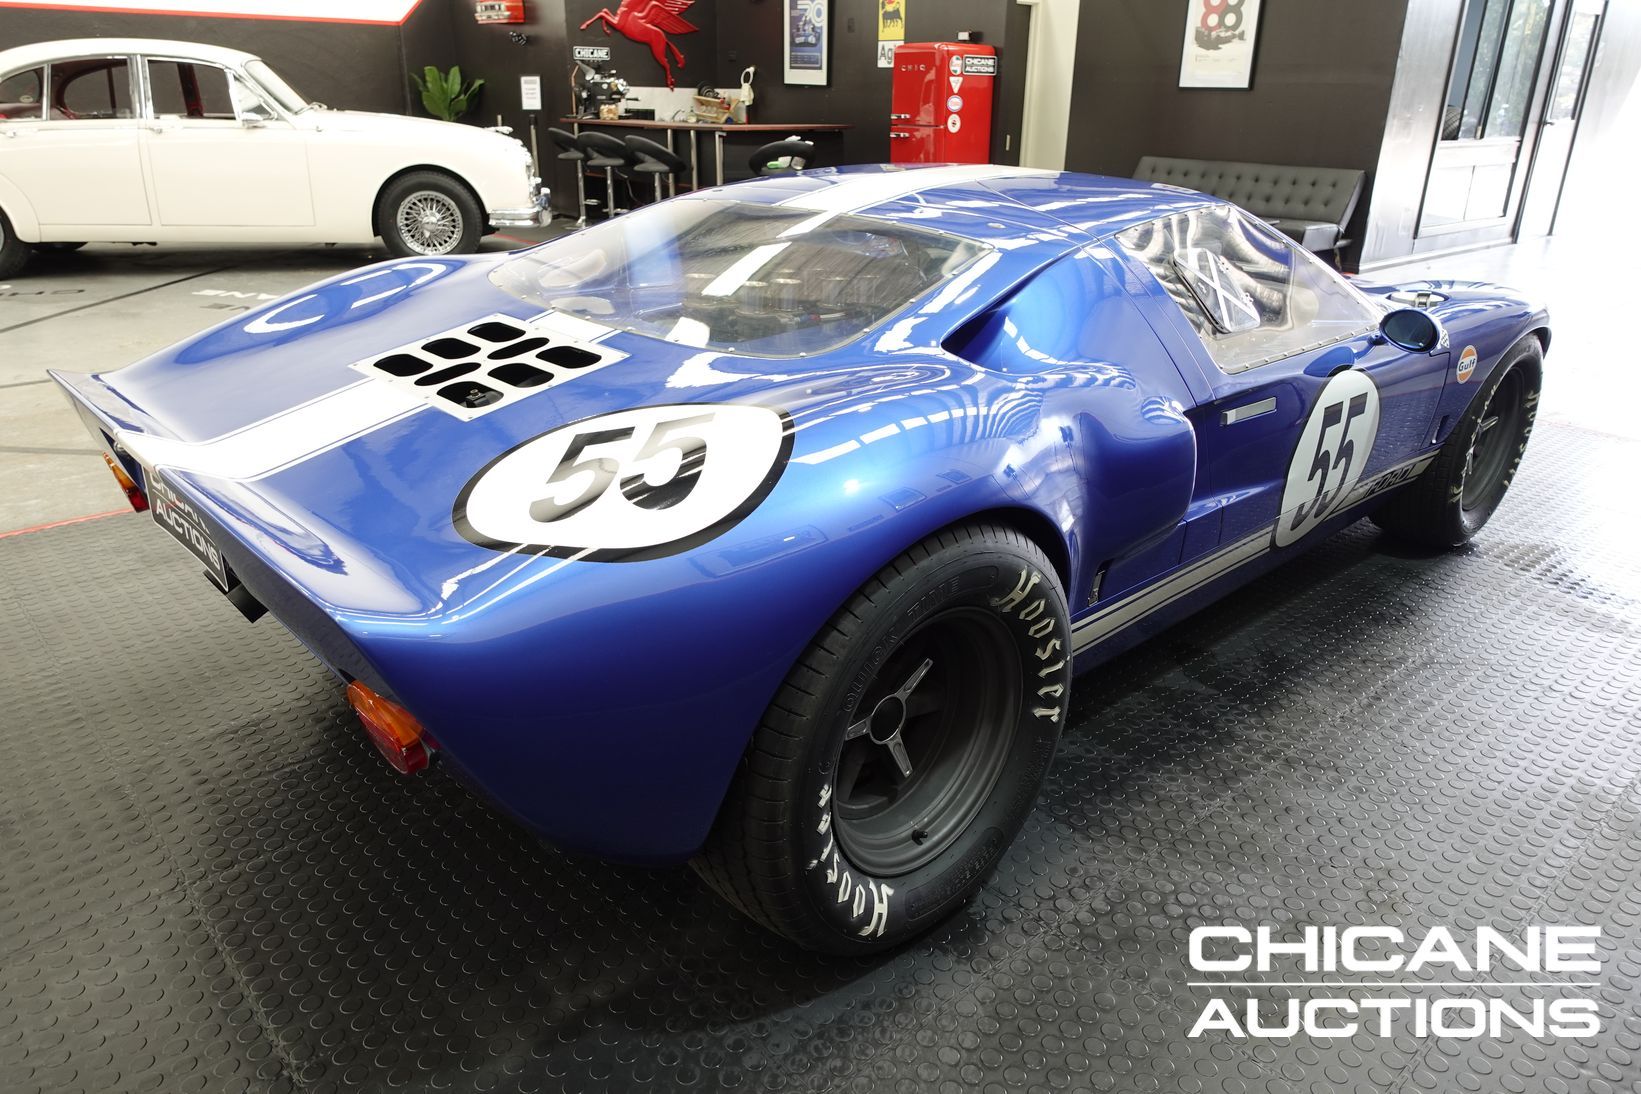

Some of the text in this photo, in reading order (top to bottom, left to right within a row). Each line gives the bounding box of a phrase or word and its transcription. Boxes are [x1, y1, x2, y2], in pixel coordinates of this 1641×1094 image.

[575, 48, 608, 58] CHICANE
[1459, 358, 1476, 372] Gulf
[529, 412, 716, 523] 55
[1290, 391, 1368, 531] 55
[155, 499, 221, 571] AUCTIONS
